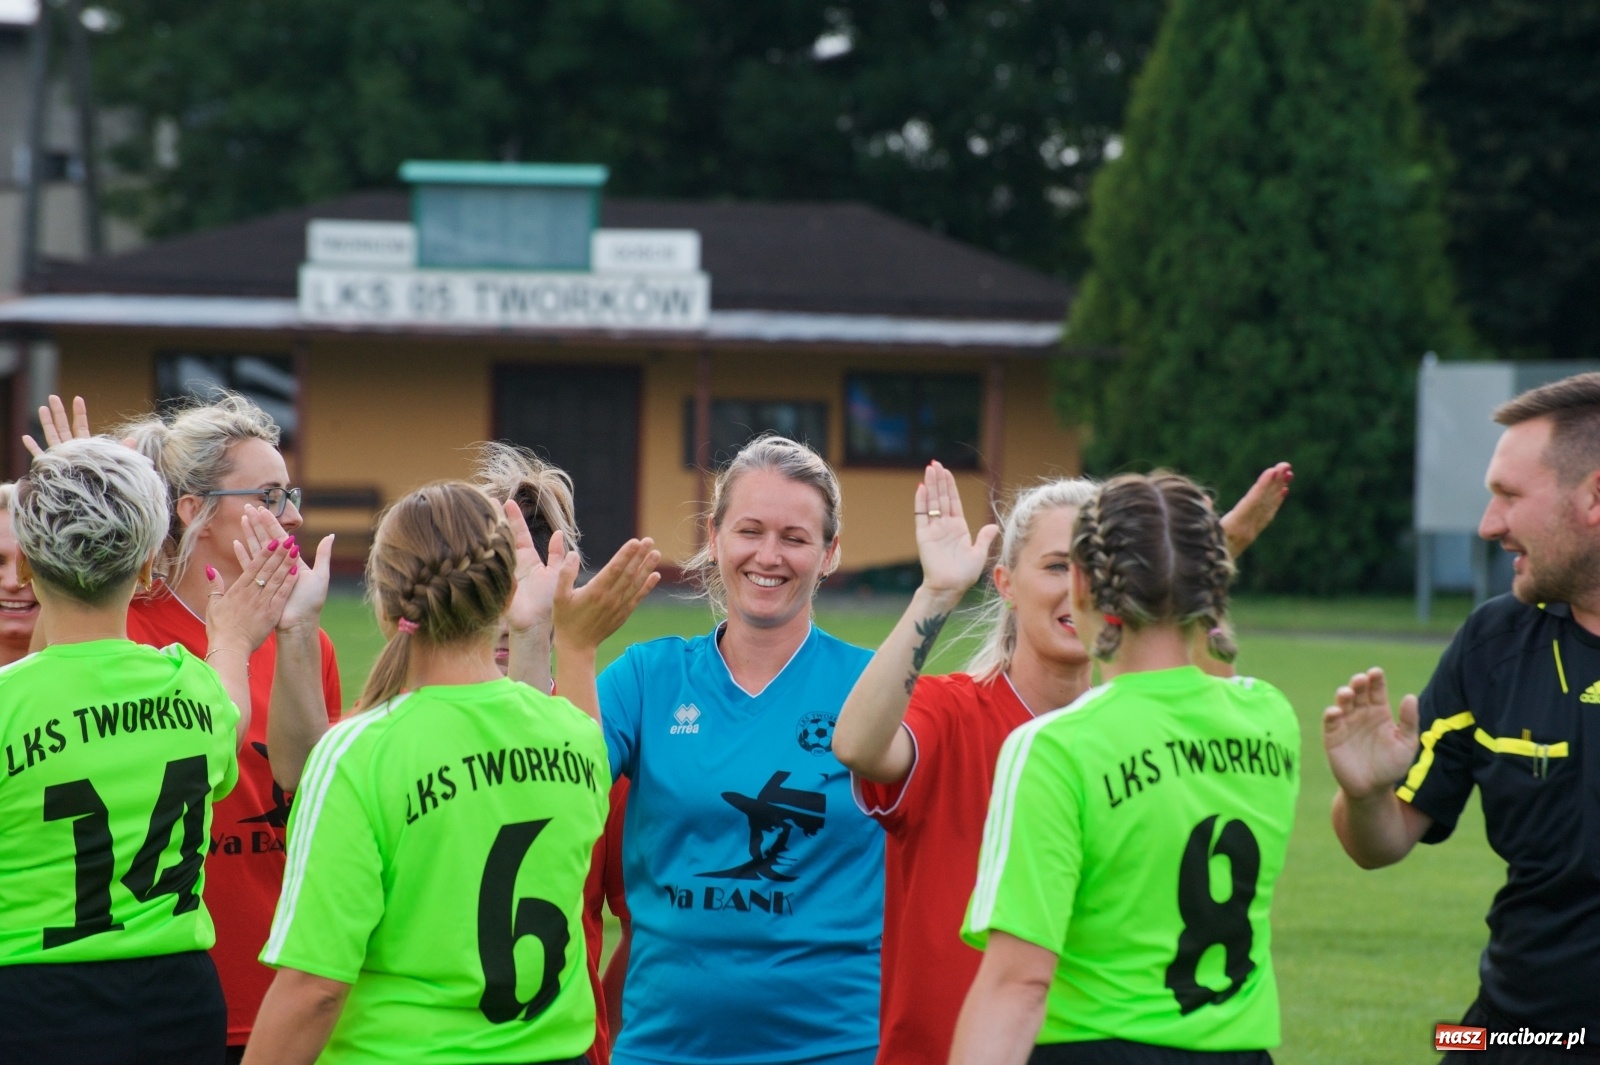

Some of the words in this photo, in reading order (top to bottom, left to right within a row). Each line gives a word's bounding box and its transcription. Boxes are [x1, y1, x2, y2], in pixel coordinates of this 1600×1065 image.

[311, 280, 394, 315] LKS
[475, 275, 695, 319] TWORKÓW
[5, 719, 66, 777] LKS
[73, 690, 213, 743] TWORKÓW
[1104, 750, 1161, 808] LKS
[1165, 732, 1296, 783] TWORKÓW
[406, 766, 457, 825] LKS
[462, 742, 597, 794] TWORKÓW
[43, 754, 212, 950] 14
[252, 831, 286, 855] BA
[477, 817, 570, 1025] 6
[663, 885, 694, 910] Va
[703, 886, 796, 916] BANK
[1165, 814, 1261, 1017] 8
